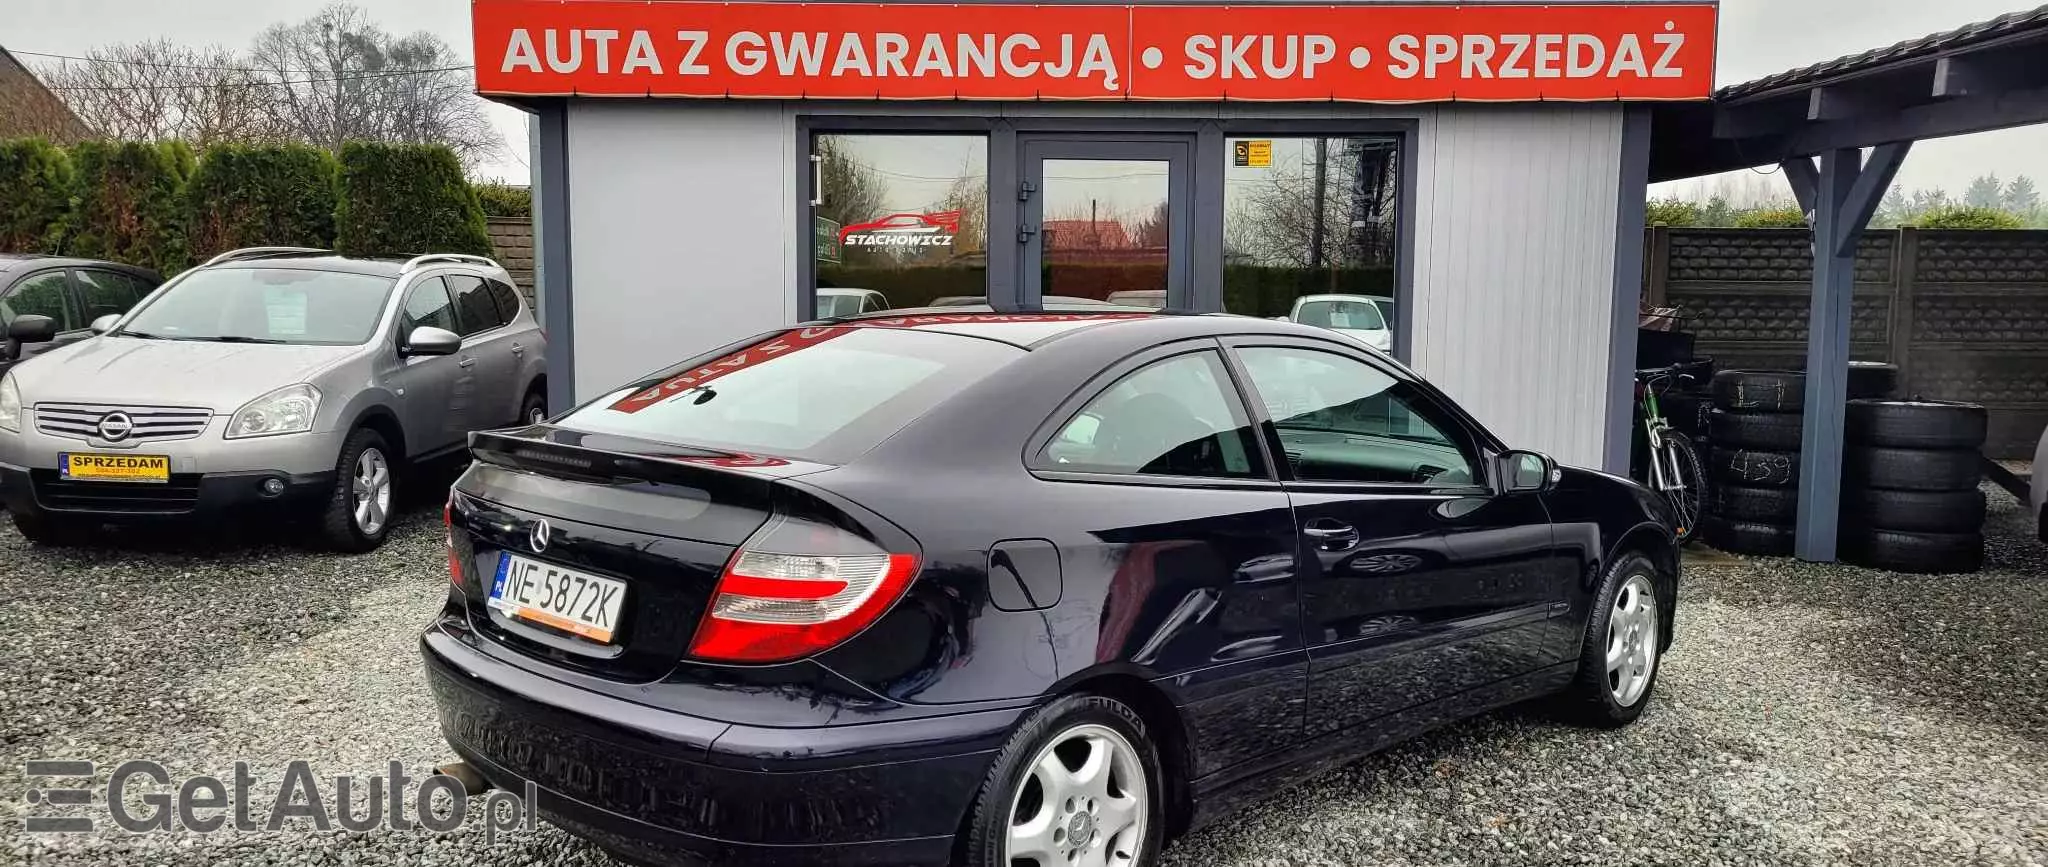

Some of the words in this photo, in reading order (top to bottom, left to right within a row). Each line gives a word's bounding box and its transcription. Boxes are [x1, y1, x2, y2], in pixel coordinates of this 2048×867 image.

[500, 28, 663, 75] AUTA
[677, 31, 709, 75] Z
[725, 31, 1119, 91] GWARANCJĄ
[1183, 34, 1336, 79] SKUP
[1387, 21, 1685, 79] SPRZEDAŻ
[844, 234, 952, 245] STACHOWICZ
[73, 456, 163, 469] SPRZEDAM
[506, 560, 538, 604] NE
[540, 570, 618, 627] 5872K
